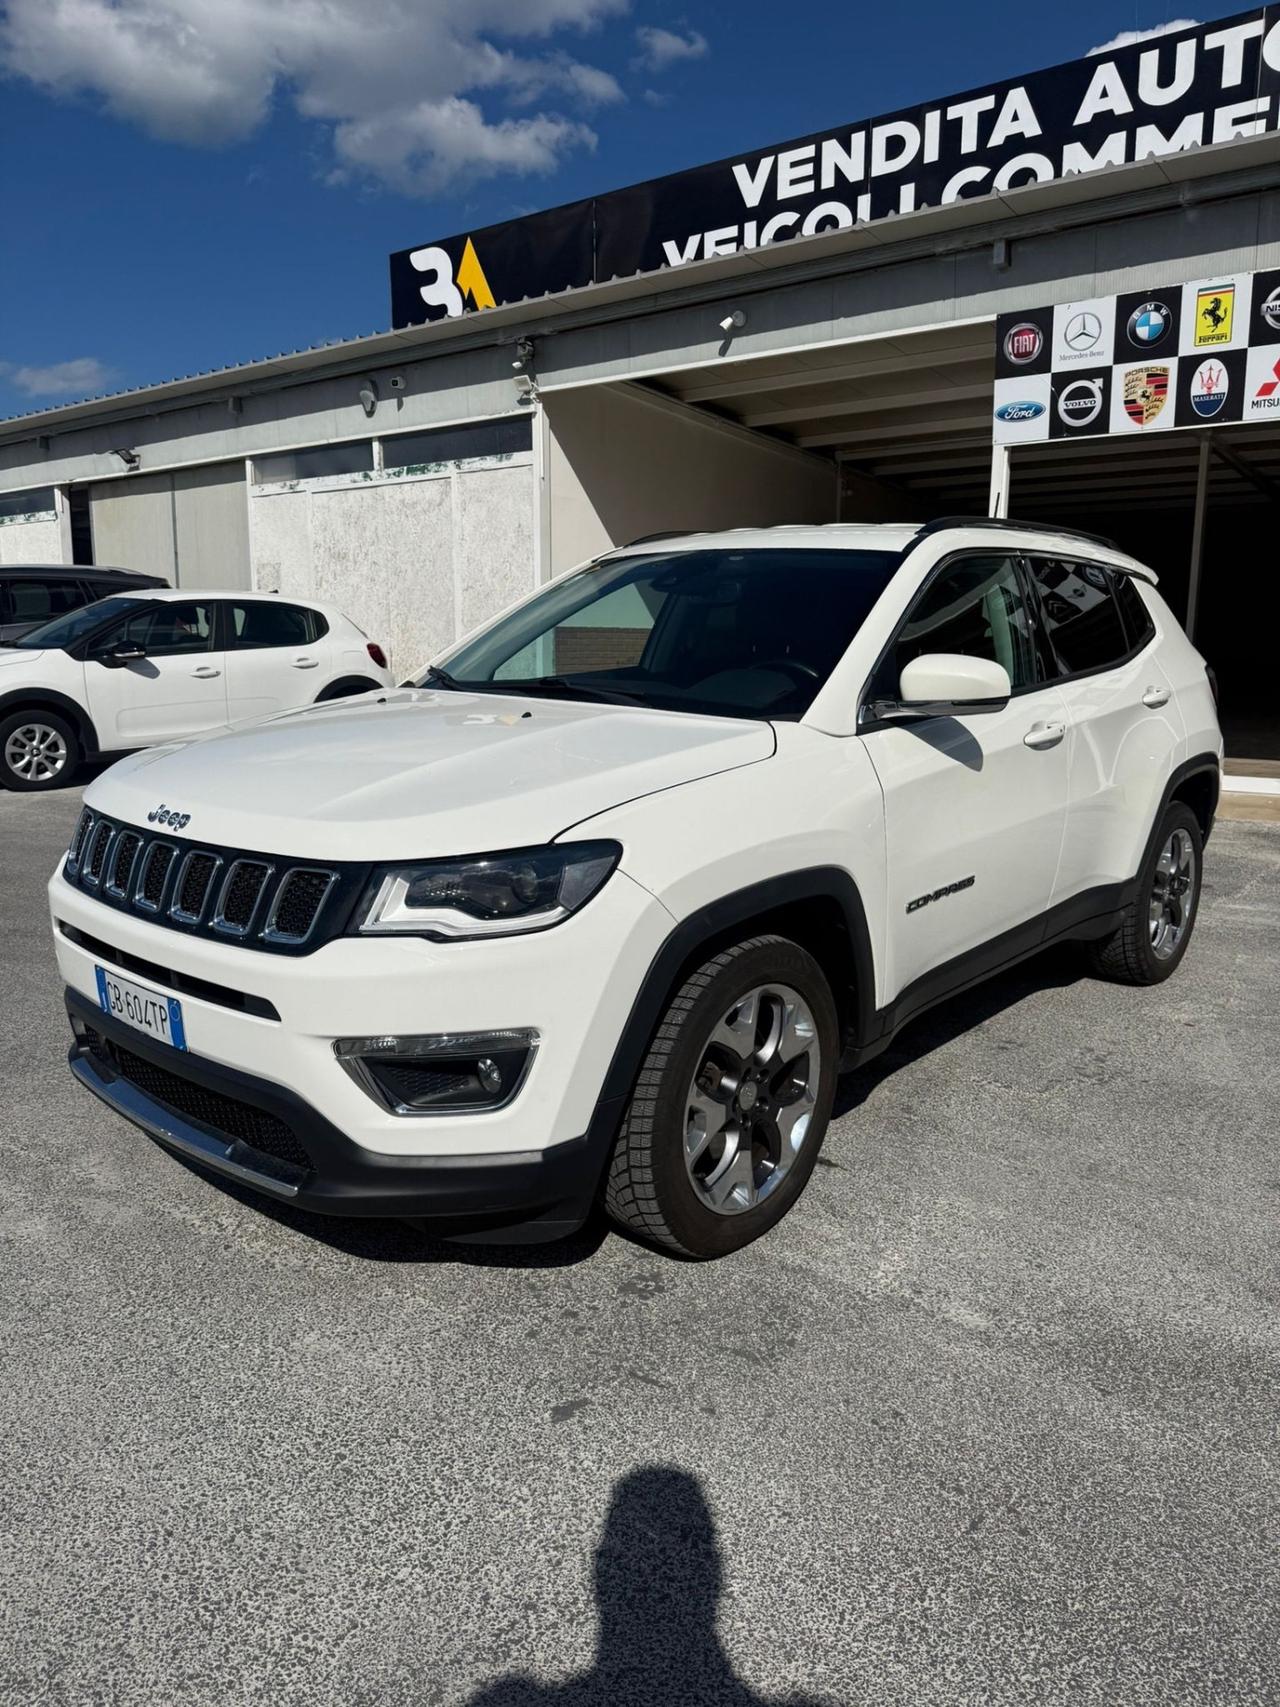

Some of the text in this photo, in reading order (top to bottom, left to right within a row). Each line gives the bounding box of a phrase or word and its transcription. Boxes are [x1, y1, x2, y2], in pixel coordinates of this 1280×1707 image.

[732, 19, 1280, 208] VENDITA AUT
[941, 96, 1280, 206] COMME
[1132, 304, 1169, 320] BMW
[1014, 334, 1035, 354] FIAT
[1198, 333, 1228, 344] Ferrari
[1124, 366, 1169, 378] PORSCHE
[1064, 400, 1096, 408] VOLVO
[1194, 394, 1224, 402] MASERATI
[1005, 405, 1036, 419] Ford
[147, 804, 191, 832] Jeep
[906, 875, 975, 914] COMPASS
[125, 991, 167, 1035] 604TP
